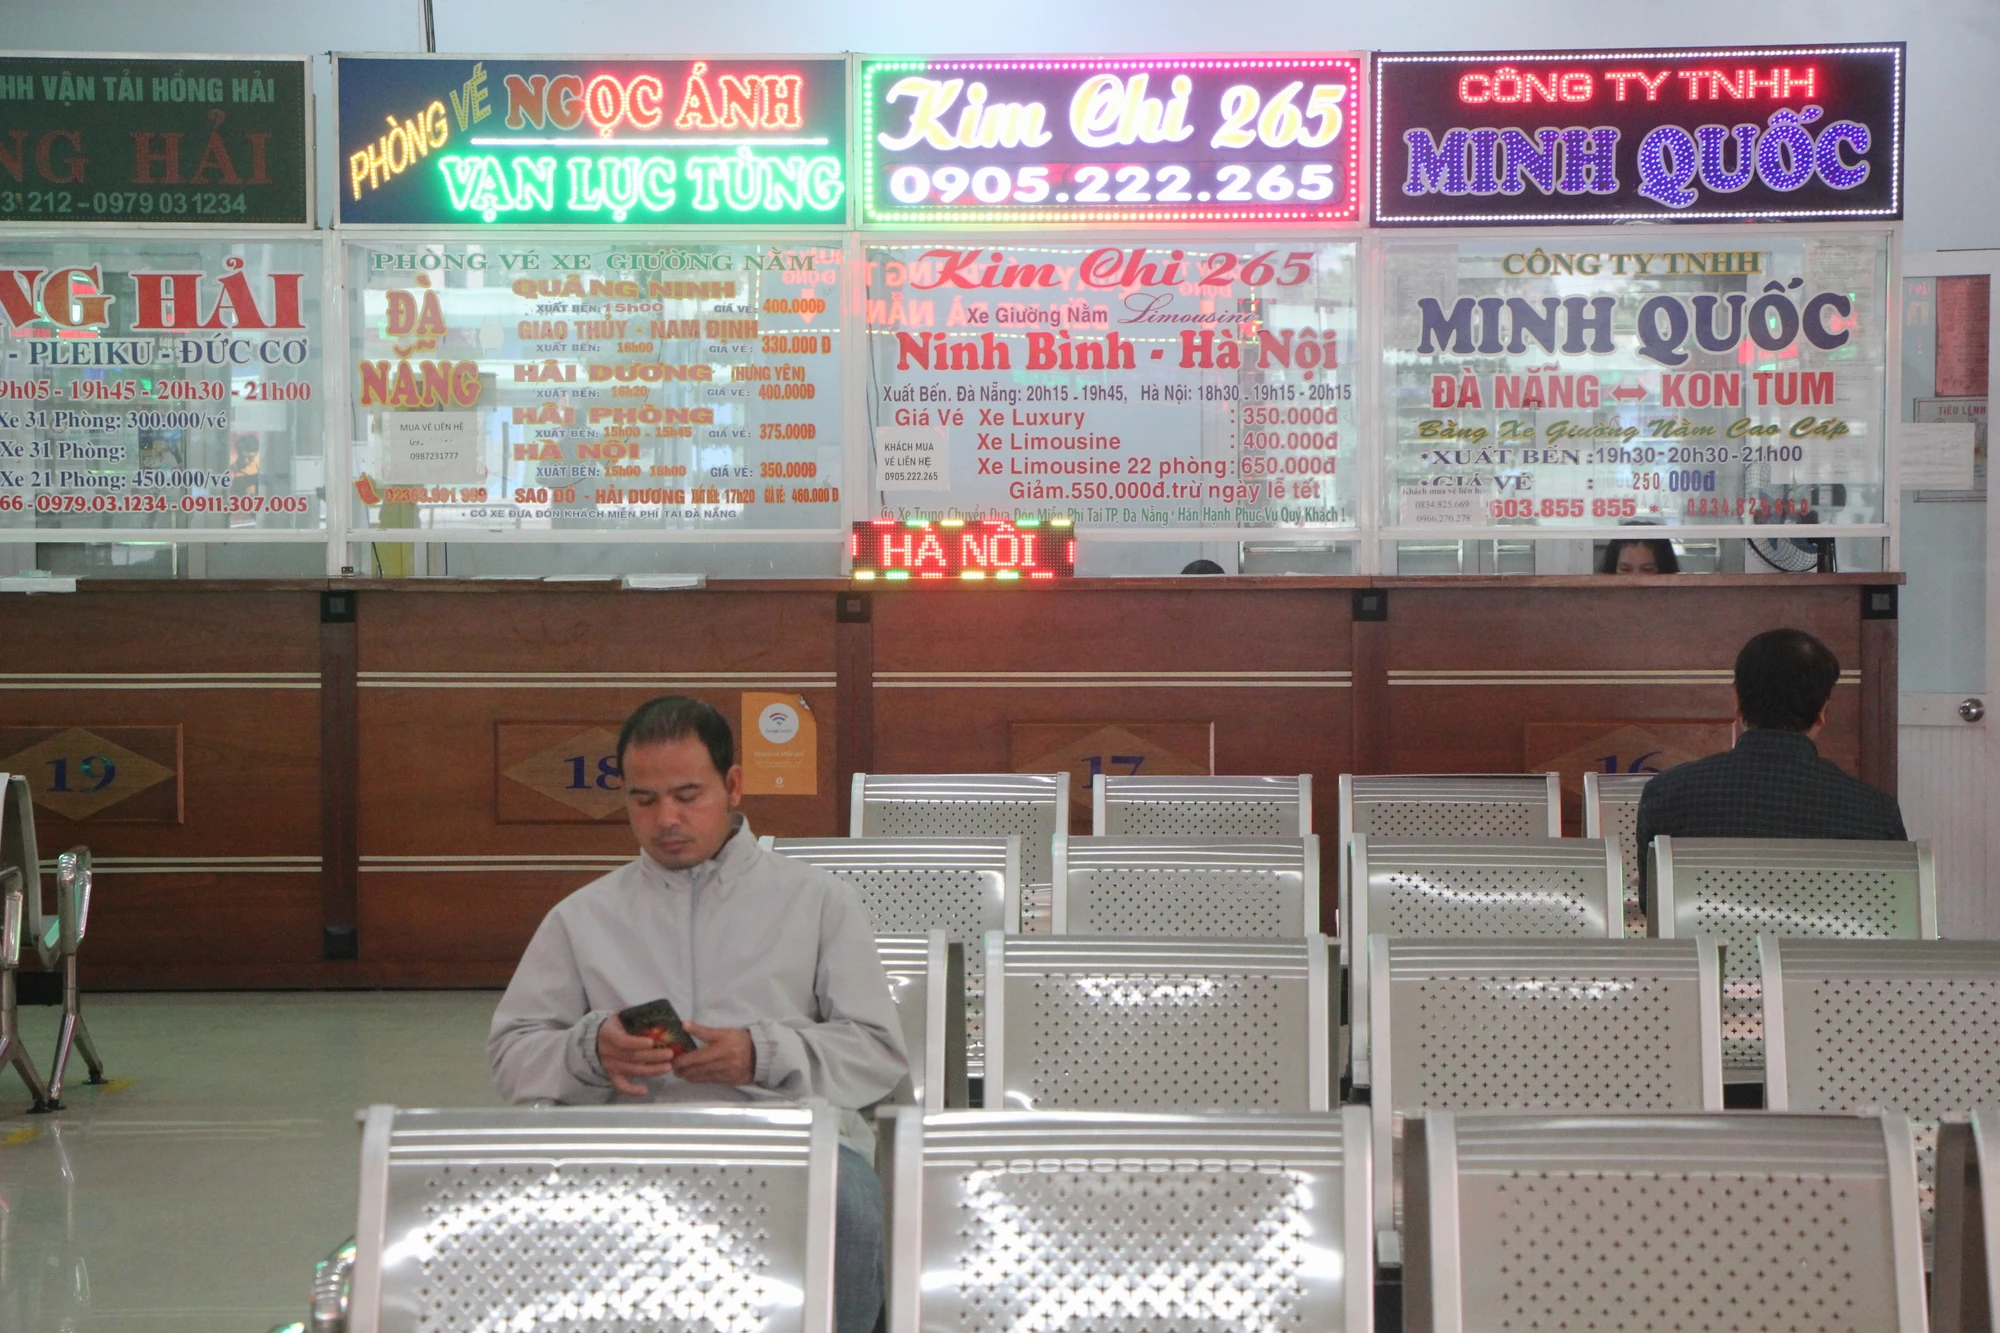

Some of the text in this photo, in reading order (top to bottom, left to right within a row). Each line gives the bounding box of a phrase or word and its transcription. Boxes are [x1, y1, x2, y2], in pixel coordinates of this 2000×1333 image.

[42, 71, 95, 106] VẬN
[103, 69, 143, 101] TẢI
[152, 69, 223, 102] HỒNG
[233, 70, 274, 102] HẢI
[1459, 67, 1816, 103] CÔNG TY TNHH
[504, 74, 663, 138] NGỌC
[878, 73, 1346, 151] Kim Chi 265
[350, 61, 491, 201] PHÒNG VÉ
[129, 109, 272, 185] HẢI
[1402, 105, 1871, 208] MINH QUỐC
[438, 156, 556, 222] VẠN
[890, 165, 1334, 204] 0905.222.265
[373, 248, 488, 270] PHÒNG
[498, 250, 539, 270] VÉ
[551, 254, 591, 270] XE
[606, 248, 733, 271] GIƯỜNG
[744, 247, 815, 271] NẰM
[911, 249, 1062, 289] Kim
[1079, 248, 1184, 288] Chi
[1200, 250, 1314, 286] 265
[1502, 247, 1762, 276] CÔNG TY TNHH
[131, 257, 305, 328] HẢI
[648, 280, 736, 299] NINH
[386, 274, 447, 337] ĐÀ
[603, 303, 663, 312] 15h00
[967, 309, 989, 323] Xe
[996, 308, 1060, 326] Giường
[1068, 304, 1107, 323] Nằm
[1118, 293, 1257, 323] Limousine
[518, 314, 758, 344] GIAO THỦY NAM ĐỊNH
[1417, 297, 1616, 354] MINH
[1638, 278, 1850, 366] QUỐC
[29, 333, 307, 365] PLEIKU ĐỨC CƠ
[896, 326, 1338, 381] Ninh Bình Hà Nội
[358, 338, 482, 407] NẴNG
[588, 361, 713, 382] DƯƠNG
[71, 381, 311, 400] 19h45 20h30 21h00
[611, 386, 648, 397] 16h20
[884, 383, 915, 401] Xuất
[957, 384, 974, 401] Đà
[980, 382, 1021, 405] Nẵng:
[1027, 386, 1068, 401] 20h15
[1142, 385, 1161, 400] Hà
[1165, 385, 1192, 404] Nội:
[1198, 385, 1239, 400] 18h30
[1254, 385, 1295, 400] 19h15
[1309, 384, 1351, 400] 20h15
[1431, 367, 1482, 409] ĐÀ
[1494, 364, 1600, 409] NẴNG
[1662, 373, 1740, 407] KON
[1752, 372, 1834, 406] TUM
[25, 411, 226, 431] 31 Phòng: 300.000/vé
[422, 422, 432, 431] VÉ
[589, 404, 714, 425] PHÒNG
[895, 407, 1338, 429] Giá Vé Xe Luxury 350.000đ
[977, 432, 1338, 450] Xe Limousine 400.000đ
[1418, 416, 1849, 443] Bằng Xe Giường Nằm Cao Cấp
[410, 452, 458, 460] 0987231777
[514, 439, 640, 462] HÀ NỘI
[885, 441, 934, 451] KHÁCH MUA
[536, 464, 567, 477] XUẤT
[572, 463, 600, 477] BẾN:
[710, 467, 729, 477] GIÁ
[885, 456, 931, 467] VÉ LIÊN HỆ
[978, 456, 1336, 478] Xe Limousine 22 phòng: 650.000đ
[1, 470, 231, 491] Xe 21 Phòng: 450.000/vé
[885, 472, 938, 481] 0905.222.265
[1209, 477, 1320, 502] ngày lễ tết
[515, 488, 548, 503] SAO
[596, 484, 623, 504] HẢI
[628, 488, 685, 504] DƯƠNG
[725, 489, 755, 503] 17h20
[884, 523, 946, 566] HÀ
[46, 756, 116, 793] 19
